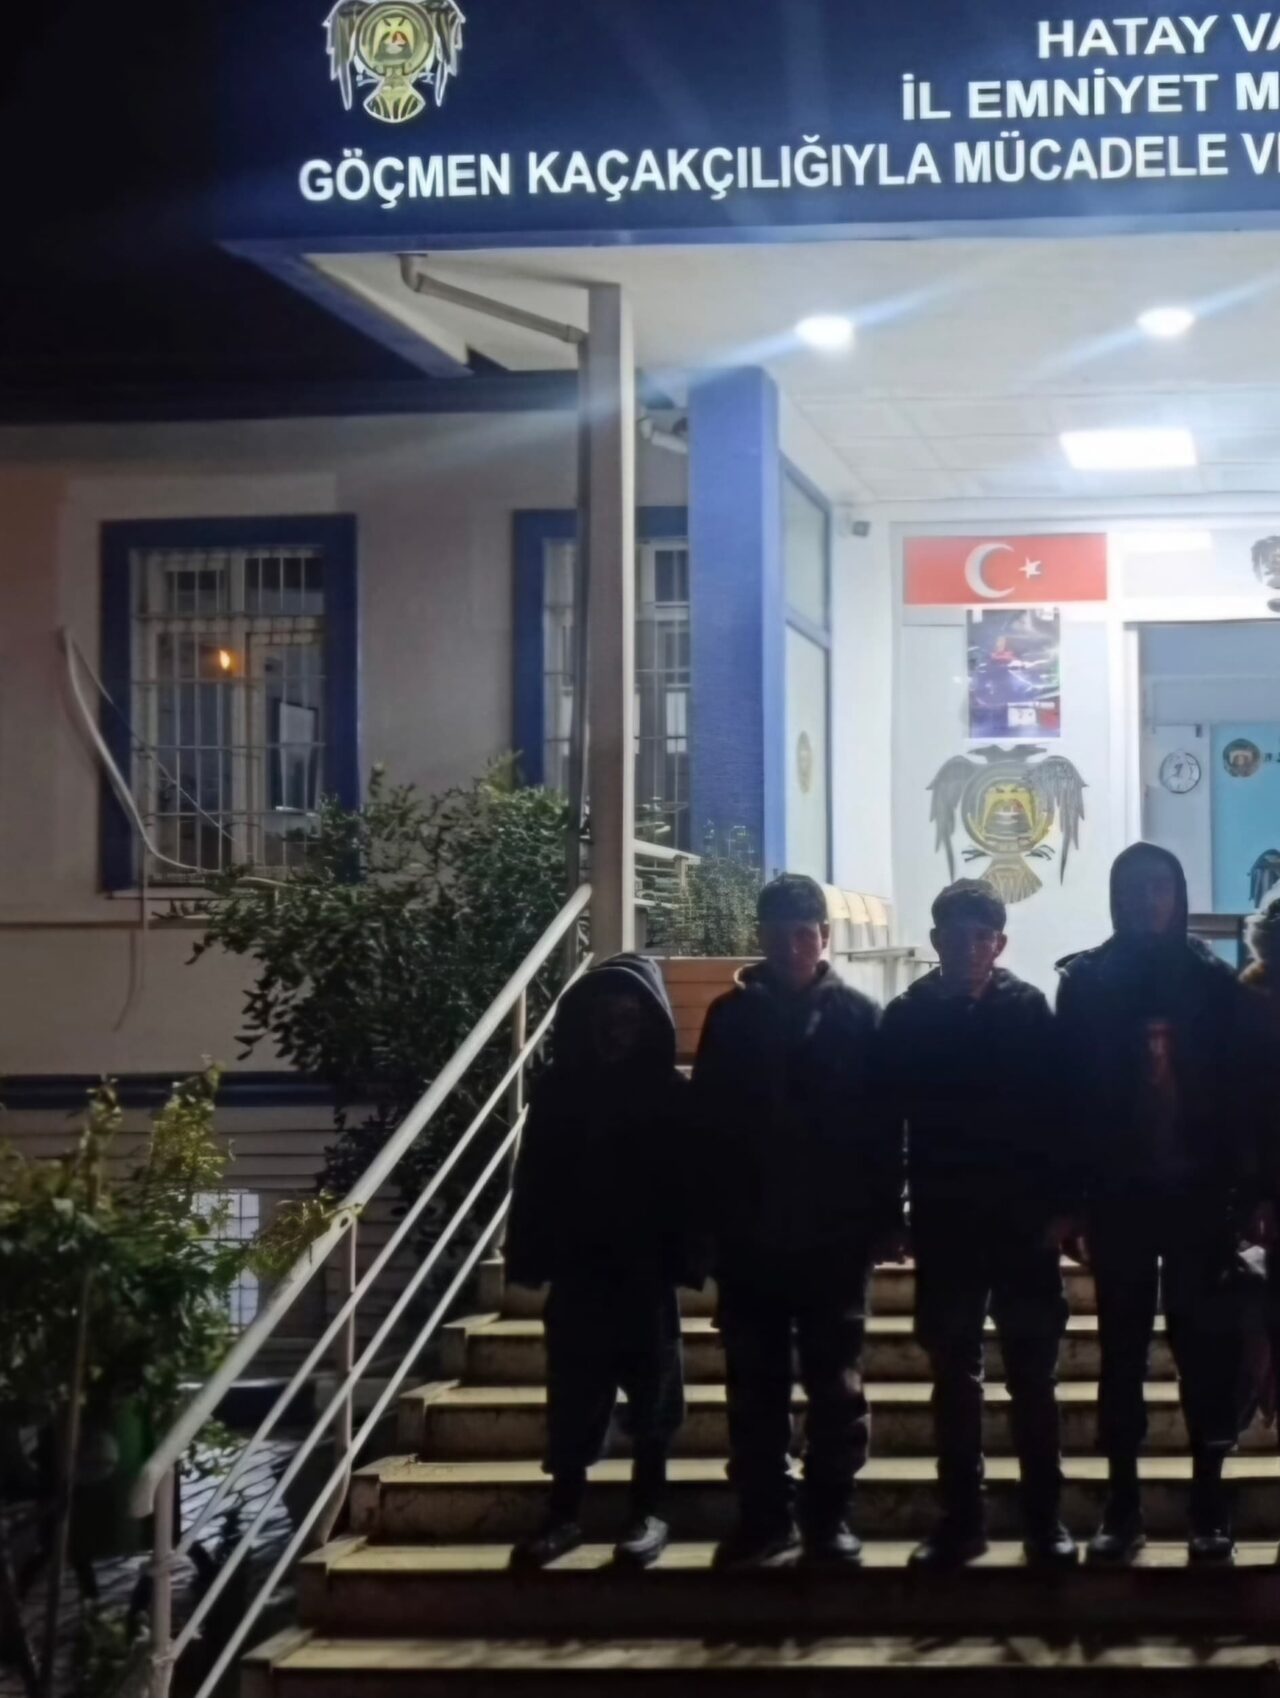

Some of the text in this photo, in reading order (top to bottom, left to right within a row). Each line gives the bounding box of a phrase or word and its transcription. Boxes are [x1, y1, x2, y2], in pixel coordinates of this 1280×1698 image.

[1037, 14, 1219, 60] HATAY
[902, 73, 952, 122] İL
[968, 67, 1219, 120] EMNİYET
[299, 148, 511, 209] GÖÇMEN
[527, 134, 943, 202] KAÇAKÇILIĞIYLA
[953, 130, 1230, 185] MÜCADELE
